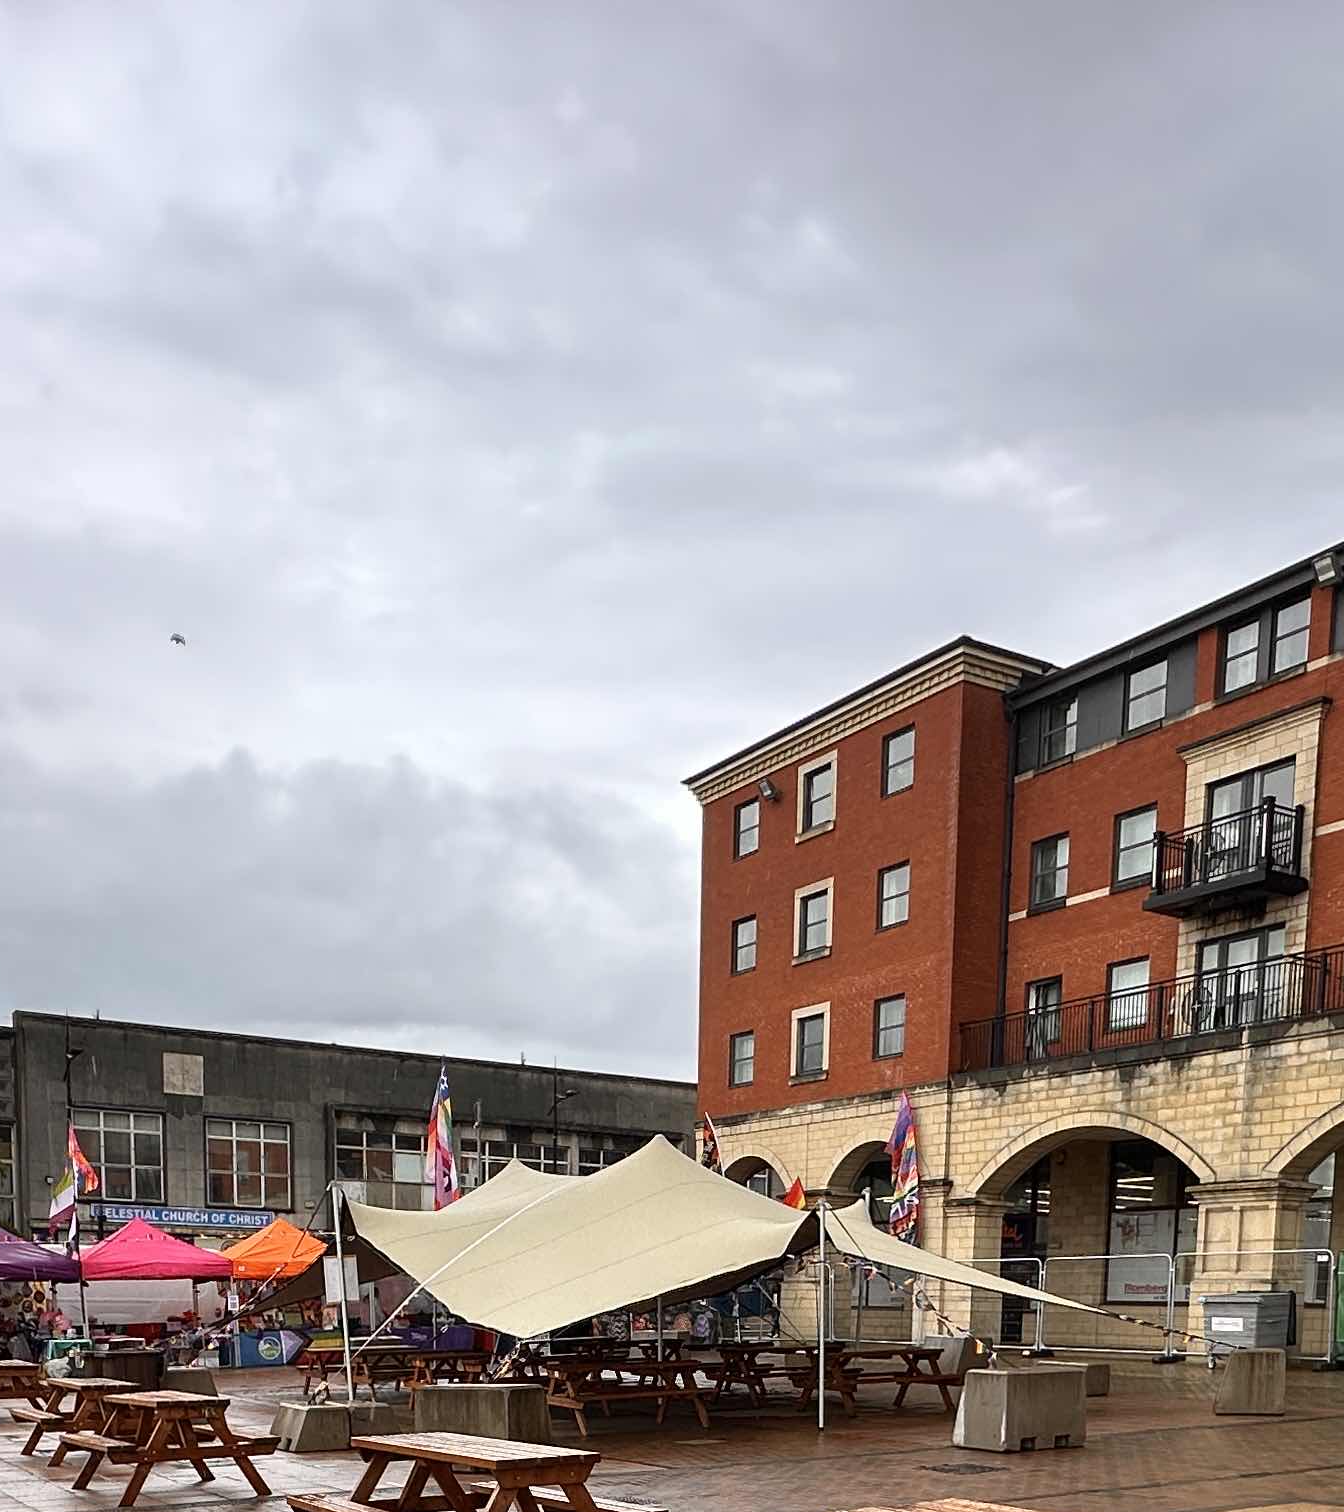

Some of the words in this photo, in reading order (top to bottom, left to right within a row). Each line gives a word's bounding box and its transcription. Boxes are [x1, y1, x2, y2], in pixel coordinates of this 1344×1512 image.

[162, 1210, 208, 1223] CHURCH
[211, 1212, 227, 1224] OF
[228, 1213, 269, 1226] CHRIST
